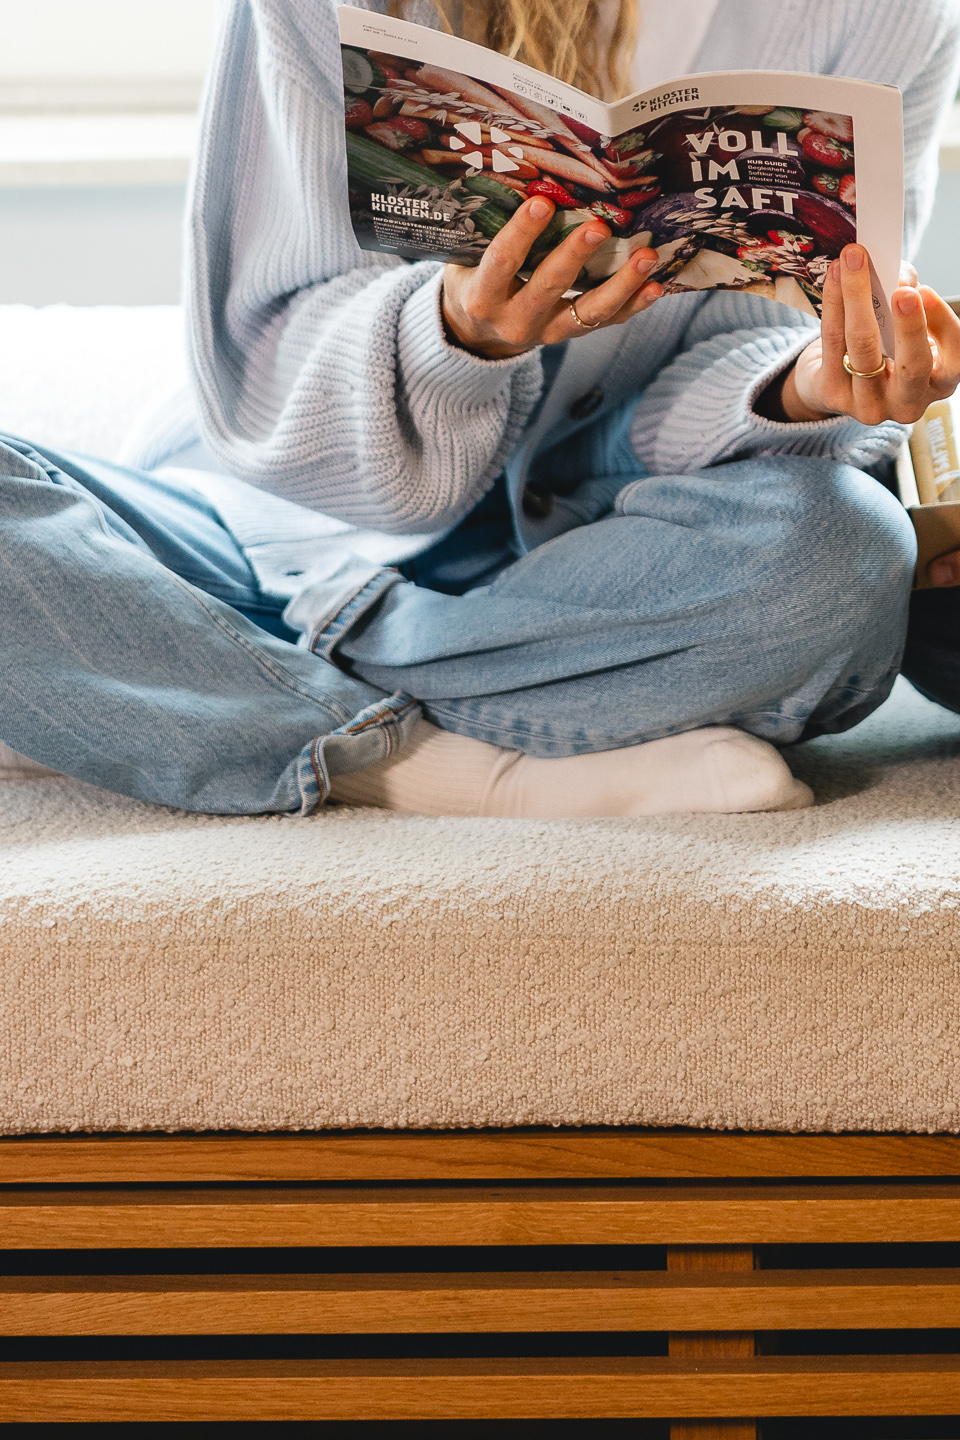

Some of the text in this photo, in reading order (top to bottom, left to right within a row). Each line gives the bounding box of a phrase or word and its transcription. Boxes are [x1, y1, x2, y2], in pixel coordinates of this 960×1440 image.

[649, 87, 699, 106] KLOSTER
[650, 94, 700, 112] KITCHEN
[686, 130, 799, 157] VOLL
[691, 159, 740, 182] IM
[774, 178, 801, 187] Kitchen
[371, 192, 430, 210] KLOSTER
[694, 186, 799, 215] SAFT
[371, 202, 451, 222] KITCHEN.DE
[373, 216, 466, 236] INFO@KLOSTERKITCHEN.COM
